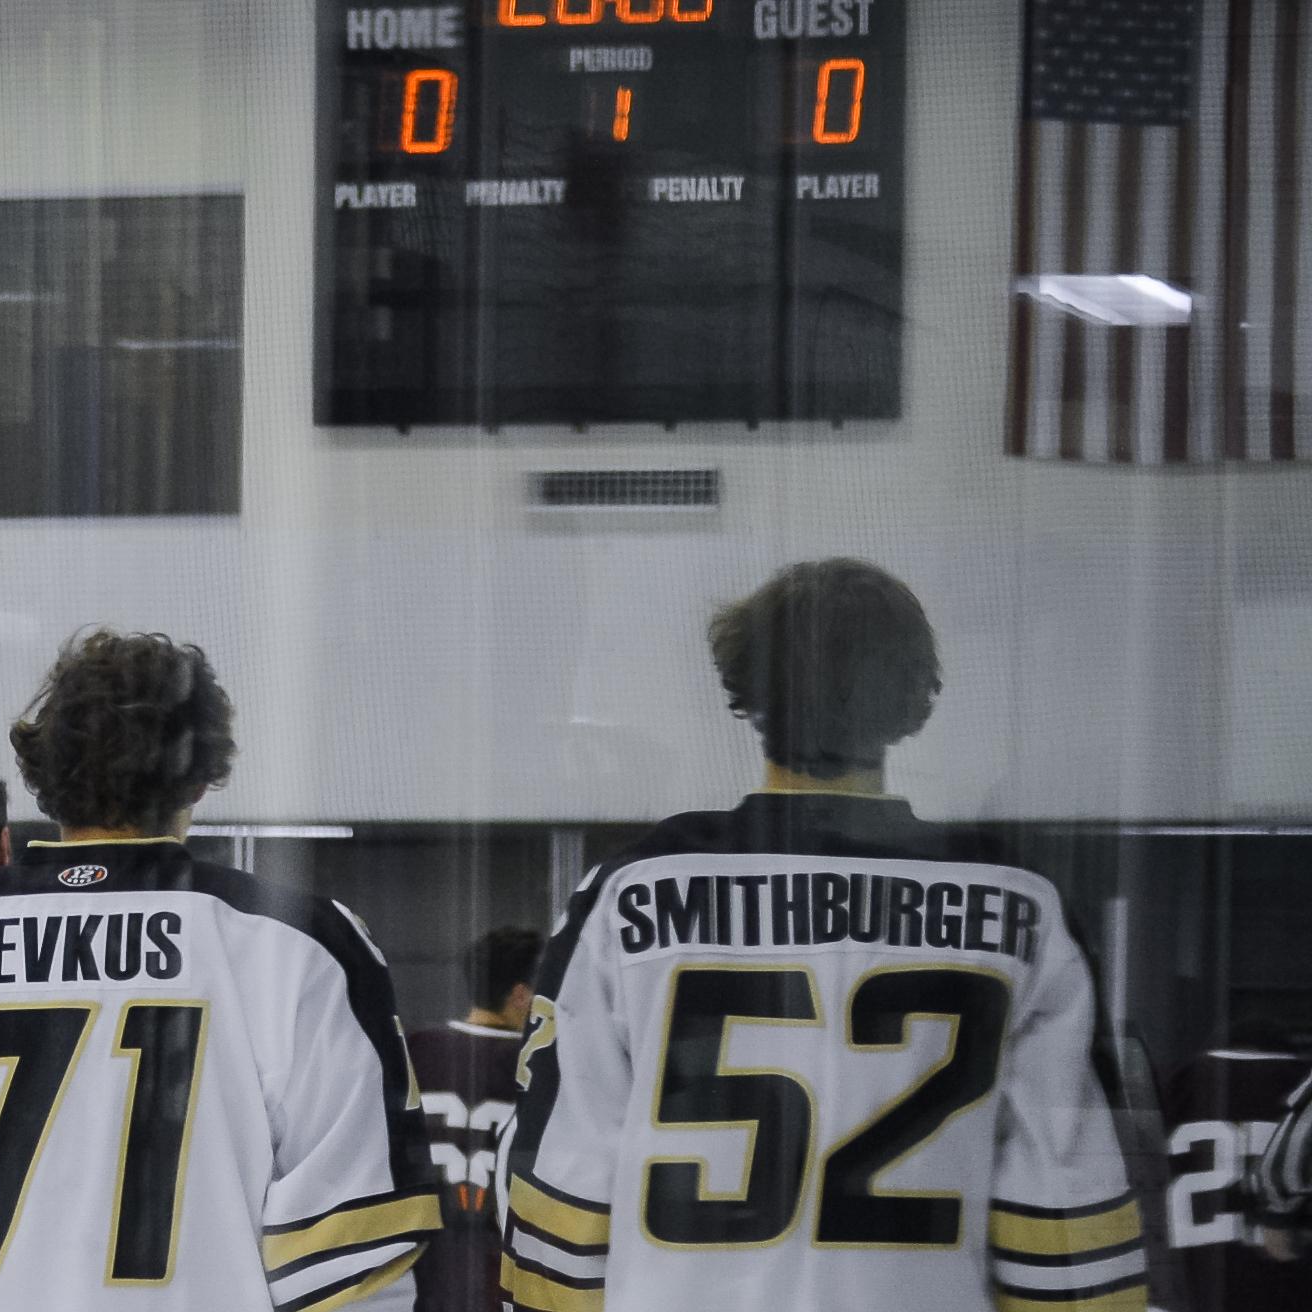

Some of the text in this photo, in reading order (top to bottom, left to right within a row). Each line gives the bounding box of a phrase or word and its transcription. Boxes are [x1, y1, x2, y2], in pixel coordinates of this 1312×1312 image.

[347, 8, 462, 49] HOME
[754, 0, 873, 39] GUEST
[570, 46, 653, 72] PERIOD
[402, 69, 458, 153] 0
[613, 86, 631, 142] 1
[812, 58, 865, 144] 0
[334, 182, 417, 208] PLAYER
[465, 178, 566, 206] PENALTY
[649, 175, 745, 202] PENALTY
[796, 173, 879, 199] PLAYER
[617, 871, 1043, 964] SMITHBURGER
[640, 961, 1014, 1251] 52
